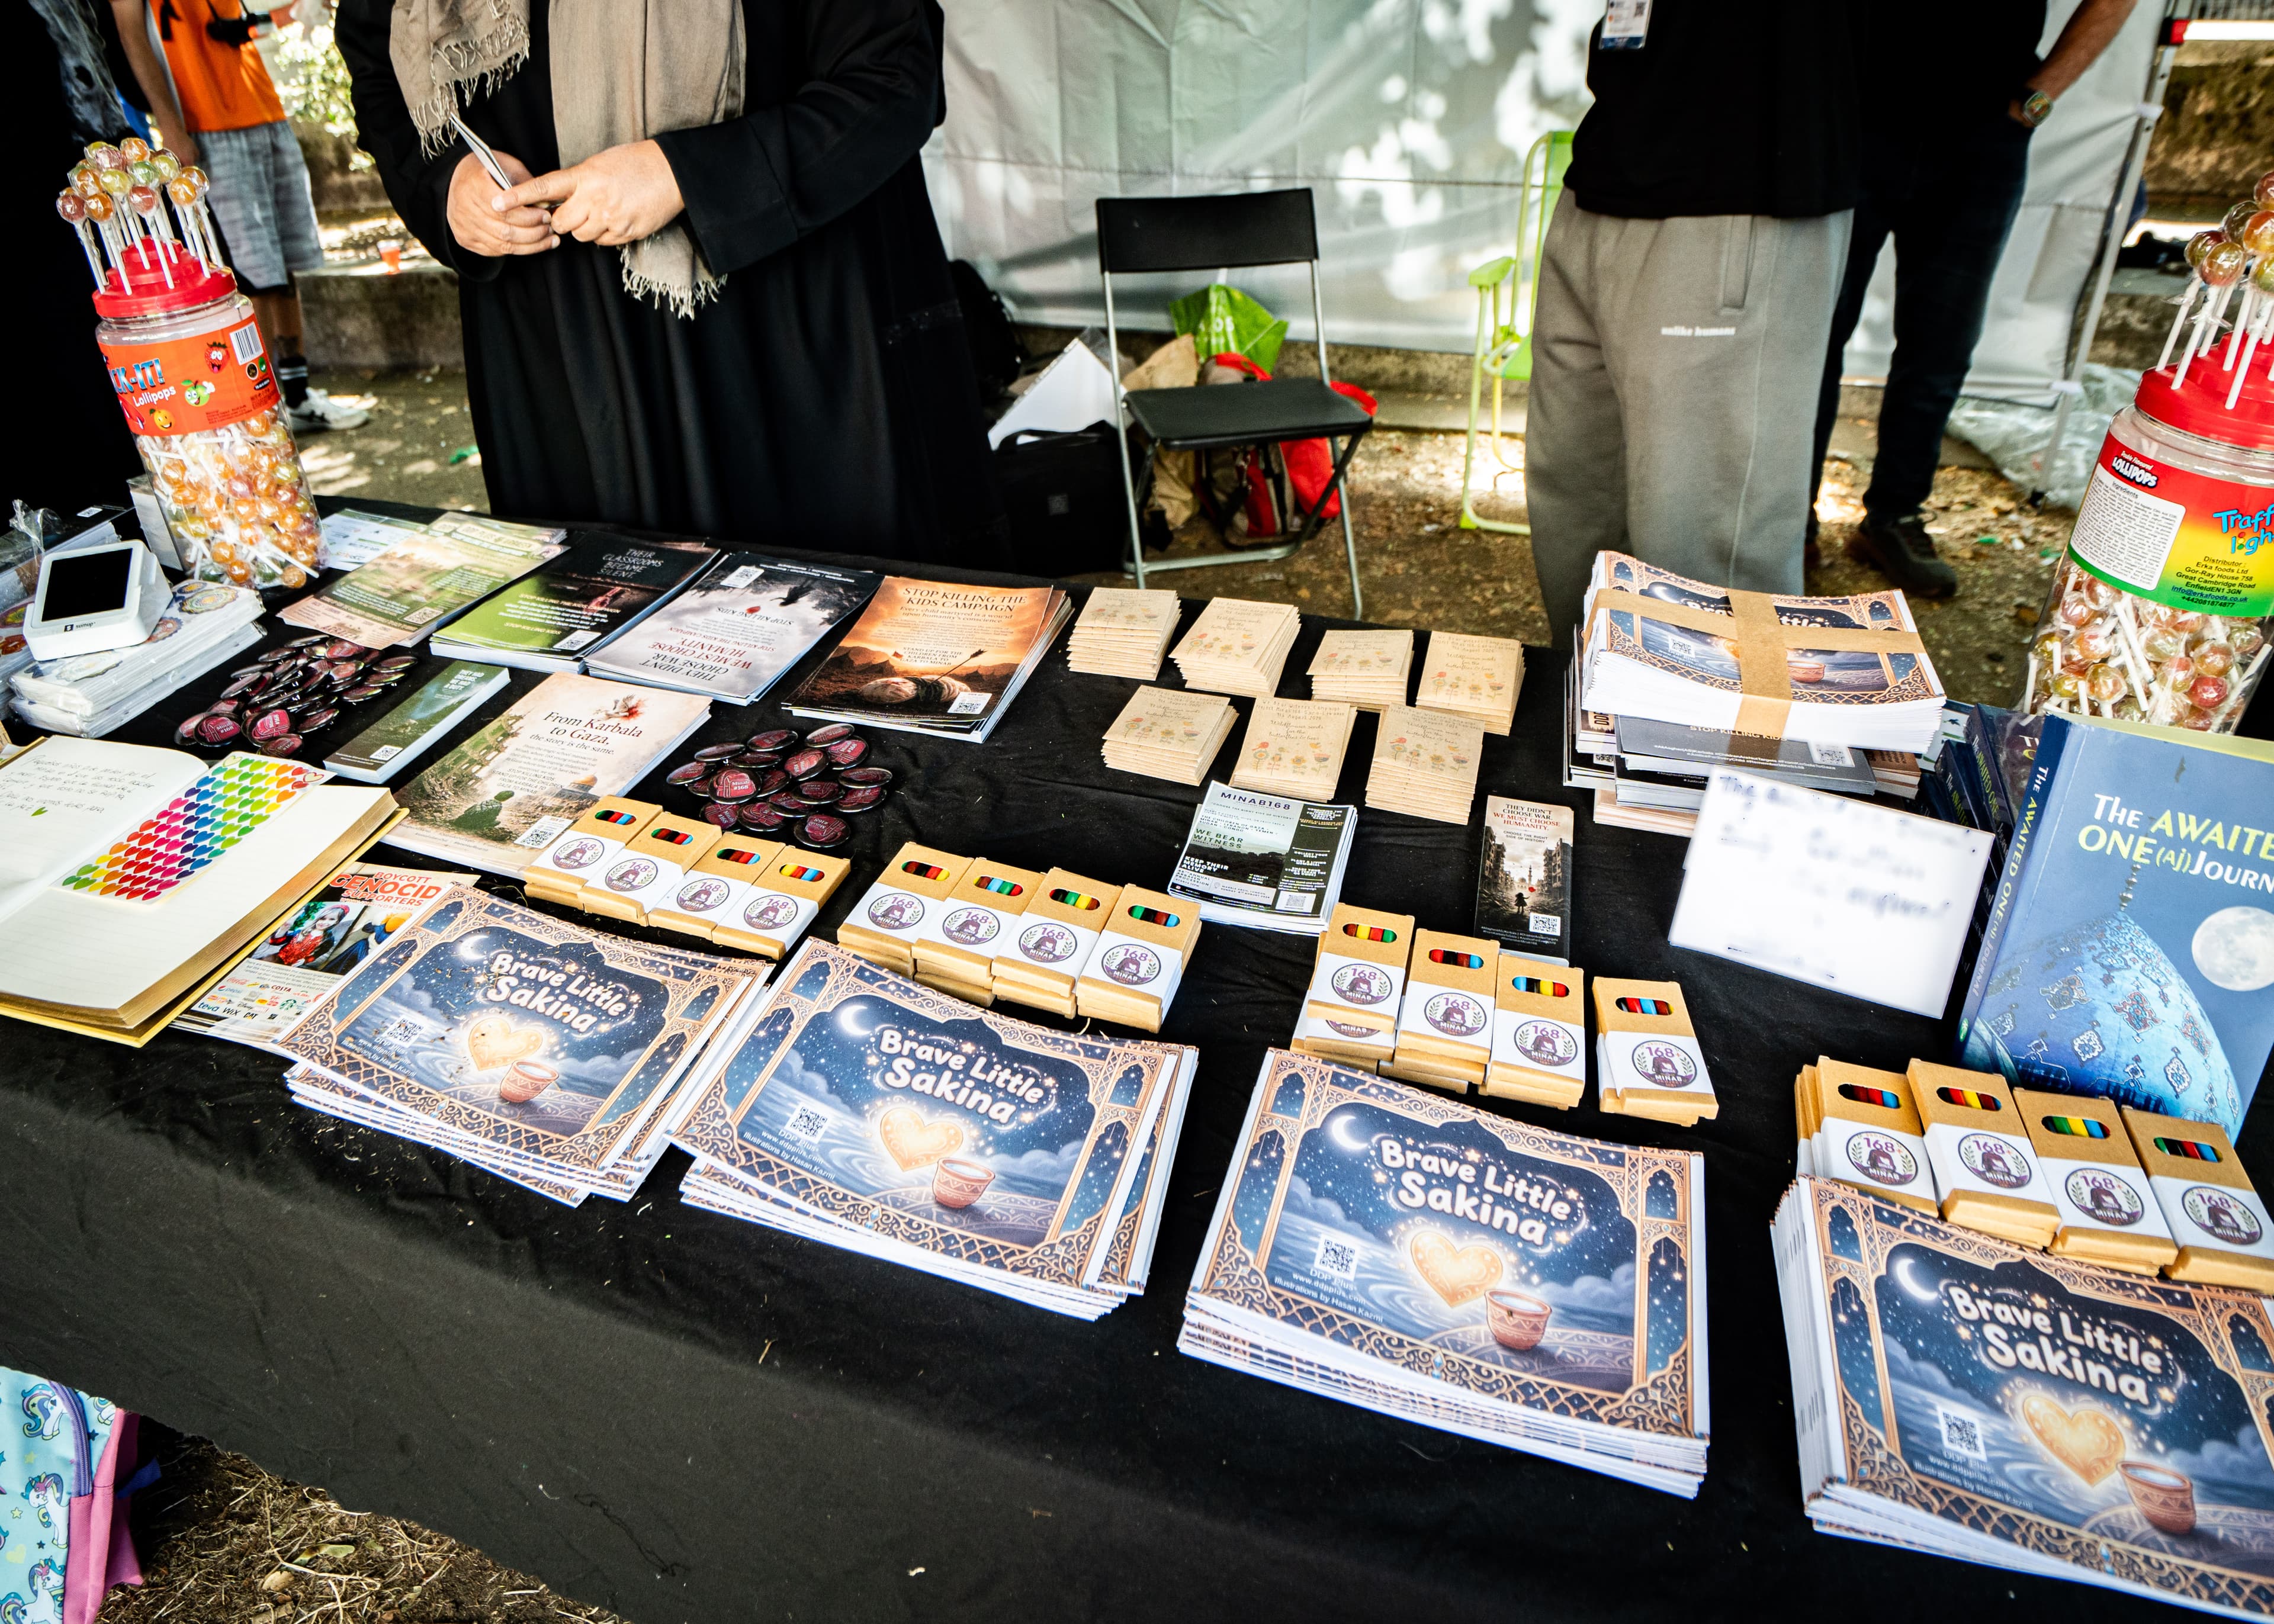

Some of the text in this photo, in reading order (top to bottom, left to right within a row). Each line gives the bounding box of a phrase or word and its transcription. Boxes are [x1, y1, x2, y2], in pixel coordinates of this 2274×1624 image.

[1695, 325, 1735, 337] humans
[108, 358, 165, 394] CK-IT!
[133, 386, 176, 407] Lollipops
[2112, 456, 2157, 487] LOLLIPOPS
[2112, 480, 2138, 499] Ingredients
[2212, 503, 2274, 533] Traff
[2231, 528, 2274, 555] ligh
[602, 553, 664, 567] CLASSROOMS
[625, 548, 656, 558] THEIR
[597, 568, 634, 578] SILENT.
[603, 562, 647, 573] BECAME
[2185, 567, 2215, 578] Gor-Ray
[2215, 565, 2234, 574] foods
[2176, 571, 2196, 581] Great
[2198, 577, 2236, 589] Cambridge
[2185, 581, 2225, 593] EnfieldEN1
[903, 587, 1027, 604] STOP KILLING THE
[2171, 585, 2249, 603] info@erkafoods.co.uk
[2182, 596, 2236, 608] +442081874877
[907, 597, 1016, 612] KIDS CAMPAIGN
[717, 606, 795, 626] STOP KIDS
[922, 613, 962, 621] humanity's
[648, 641, 753, 670] WE MUST CHOOSE
[677, 638, 747, 658] HUMANITY.
[640, 660, 717, 681] THEY DIDN'T
[652, 653, 729, 675] CHOOSE WAR.
[543, 712, 643, 738] From Karbala
[550, 726, 610, 745] to Gaza.
[1720, 729, 1760, 739] KILLING
[545, 737, 564, 746] story
[576, 742, 590, 750] the
[592, 747, 614, 755] same.
[1977, 752, 1999, 816] AWAITED ONE
[1220, 792, 1291, 810] MINAB168
[1505, 803, 1553, 815] THEY DIDN'T
[1951, 790, 1969, 827] AWAITE
[1502, 808, 1534, 818] CHOOSE
[1507, 813, 1528, 822] MUST
[1530, 818, 1561, 828] CHOOSE
[1193, 834, 1242, 849] WITNESS
[1216, 832, 1244, 843] BEAR
[2009, 796, 2037, 877] AWAITED
[2150, 809, 2274, 861] AWAITE
[576, 841, 597, 851] 168
[629, 861, 650, 873] 168
[1183, 860, 1219, 872] MEMORY
[1184, 856, 1229, 871] KEEP THEIR
[2078, 824, 2157, 865] ONE
[2188, 850, 2274, 895] JOURN
[1181, 864, 1205, 873] ALIVE
[374, 872, 432, 883] BOYCOTT
[329, 873, 442, 899] GENOCID
[700, 881, 722, 893] 168
[341, 889, 424, 907] SUPPORTERS
[767, 898, 789, 909] 168
[891, 896, 914, 909] 168
[1995, 881, 2012, 922] ONE
[965, 911, 990, 924] 168
[952, 931, 976, 942] MINAB
[1041, 927, 1065, 940] 168
[1029, 949, 1054, 960] MINAB
[1123, 948, 1149, 961] 168
[1113, 971, 1138, 982] MINAB
[1351, 967, 1377, 981] 168
[490, 952, 628, 1017] Brave Little
[1345, 991, 1373, 1001] MINAB
[1443, 997, 1470, 1011] 168
[198, 1002, 220, 1012] teva
[243, 1012, 258, 1020] CAT
[486, 975, 598, 1035] Sakina
[1340, 1024, 1367, 1034] MINAB
[1440, 1022, 1467, 1033] MINAB
[1532, 1025, 1559, 1039] 168
[1531, 1050, 1559, 1062] MINAB
[1645, 1046, 1675, 1058] 168
[879, 1028, 1045, 1104] Brave Little
[1654, 1074, 1683, 1082] MINAB
[884, 1057, 1017, 1125] Sakina
[761, 1130, 824, 1165] www.ddpplus.com
[779, 1129, 816, 1152] DDP Plus
[1862, 1137, 1895, 1153] 168
[1972, 1139, 2005, 1155] 168
[743, 1131, 835, 1180] Illustrations by Hasan Kazmi
[1380, 1139, 1572, 1222] Brave Little
[1868, 1167, 1900, 1181] MINAB
[2080, 1175, 2115, 1191] 168
[1396, 1170, 1549, 1247] Sakina
[2195, 1192, 2232, 1210] 168
[1310, 1269, 1354, 1291] DDP Plus
[1293, 1272, 1366, 1305] www.ddpplus.com
[1274, 1275, 1384, 1323] Illustrations by Hasan Kazmi
[1947, 1285, 2163, 1376] Brave Little
[1982, 1322, 2151, 1407] Sakina
